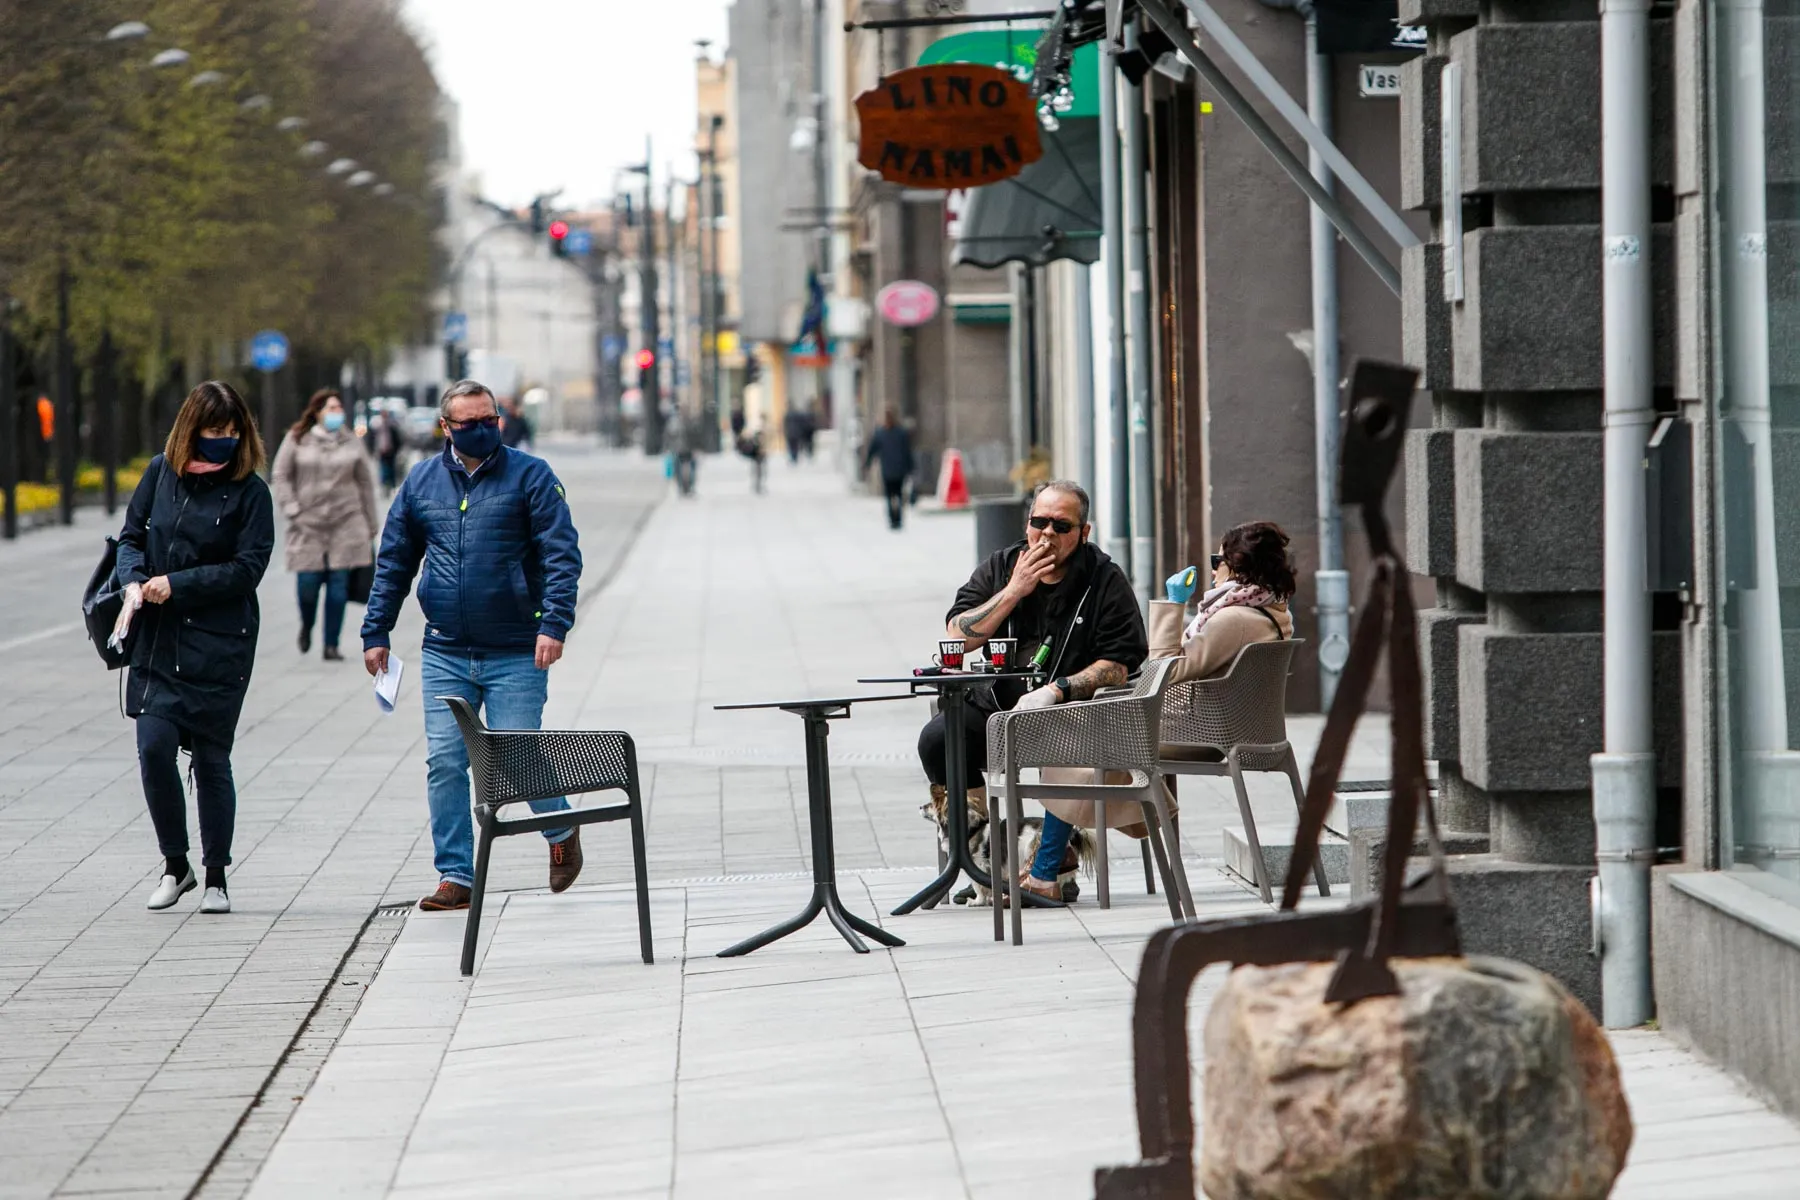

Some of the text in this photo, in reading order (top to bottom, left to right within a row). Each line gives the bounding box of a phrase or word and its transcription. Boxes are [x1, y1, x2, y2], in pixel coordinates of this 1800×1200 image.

[889, 75, 1007, 111] LINO
[1365, 70, 1401, 89] Vas
[878, 134, 1022, 178] NAMAI
[941, 642, 965, 655] VERO
